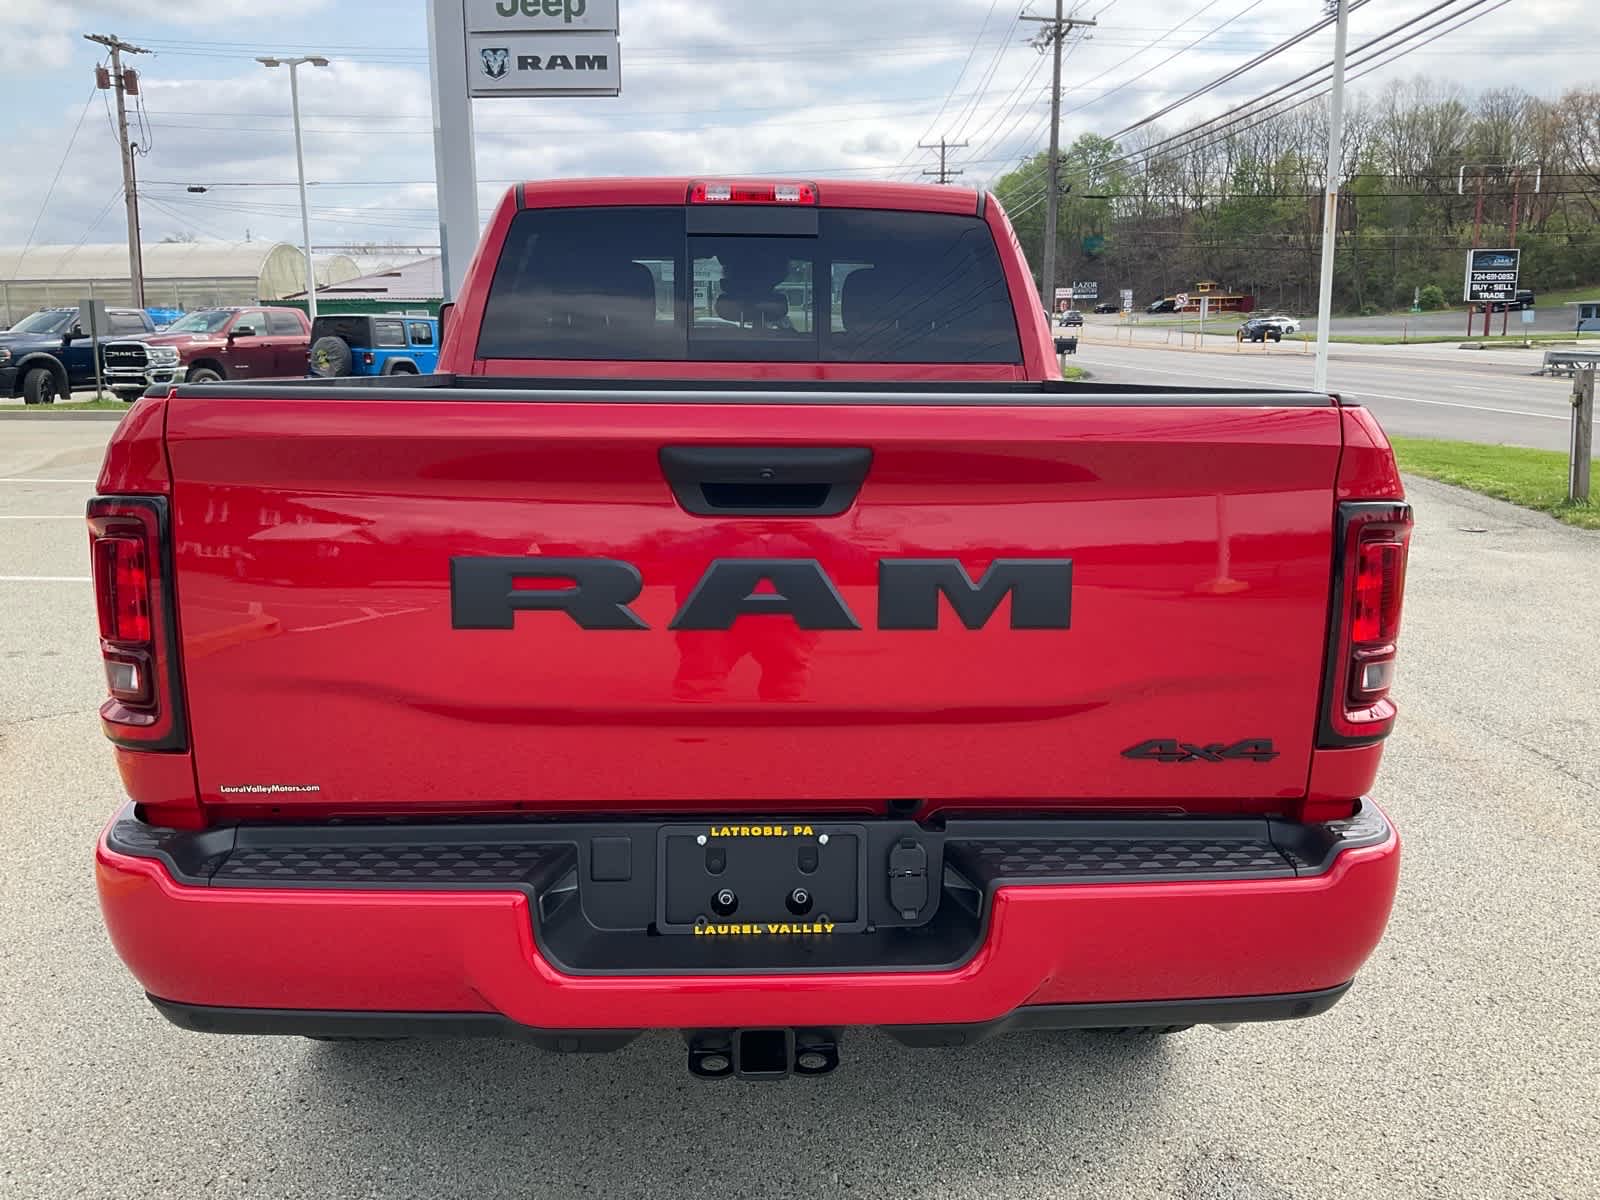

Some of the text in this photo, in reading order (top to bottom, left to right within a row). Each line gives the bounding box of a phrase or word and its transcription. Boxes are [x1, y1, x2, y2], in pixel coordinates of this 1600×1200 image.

[496, 0, 586, 23] Jeep
[518, 55, 608, 70] RAM
[449, 557, 1073, 631] RAM
[1121, 738, 1280, 762] 4x4
[220, 784, 320, 794] LaurelValleyMotors.com
[710, 825, 814, 837] LATROBE, PA
[694, 923, 835, 935] LAUREL VALLEY
